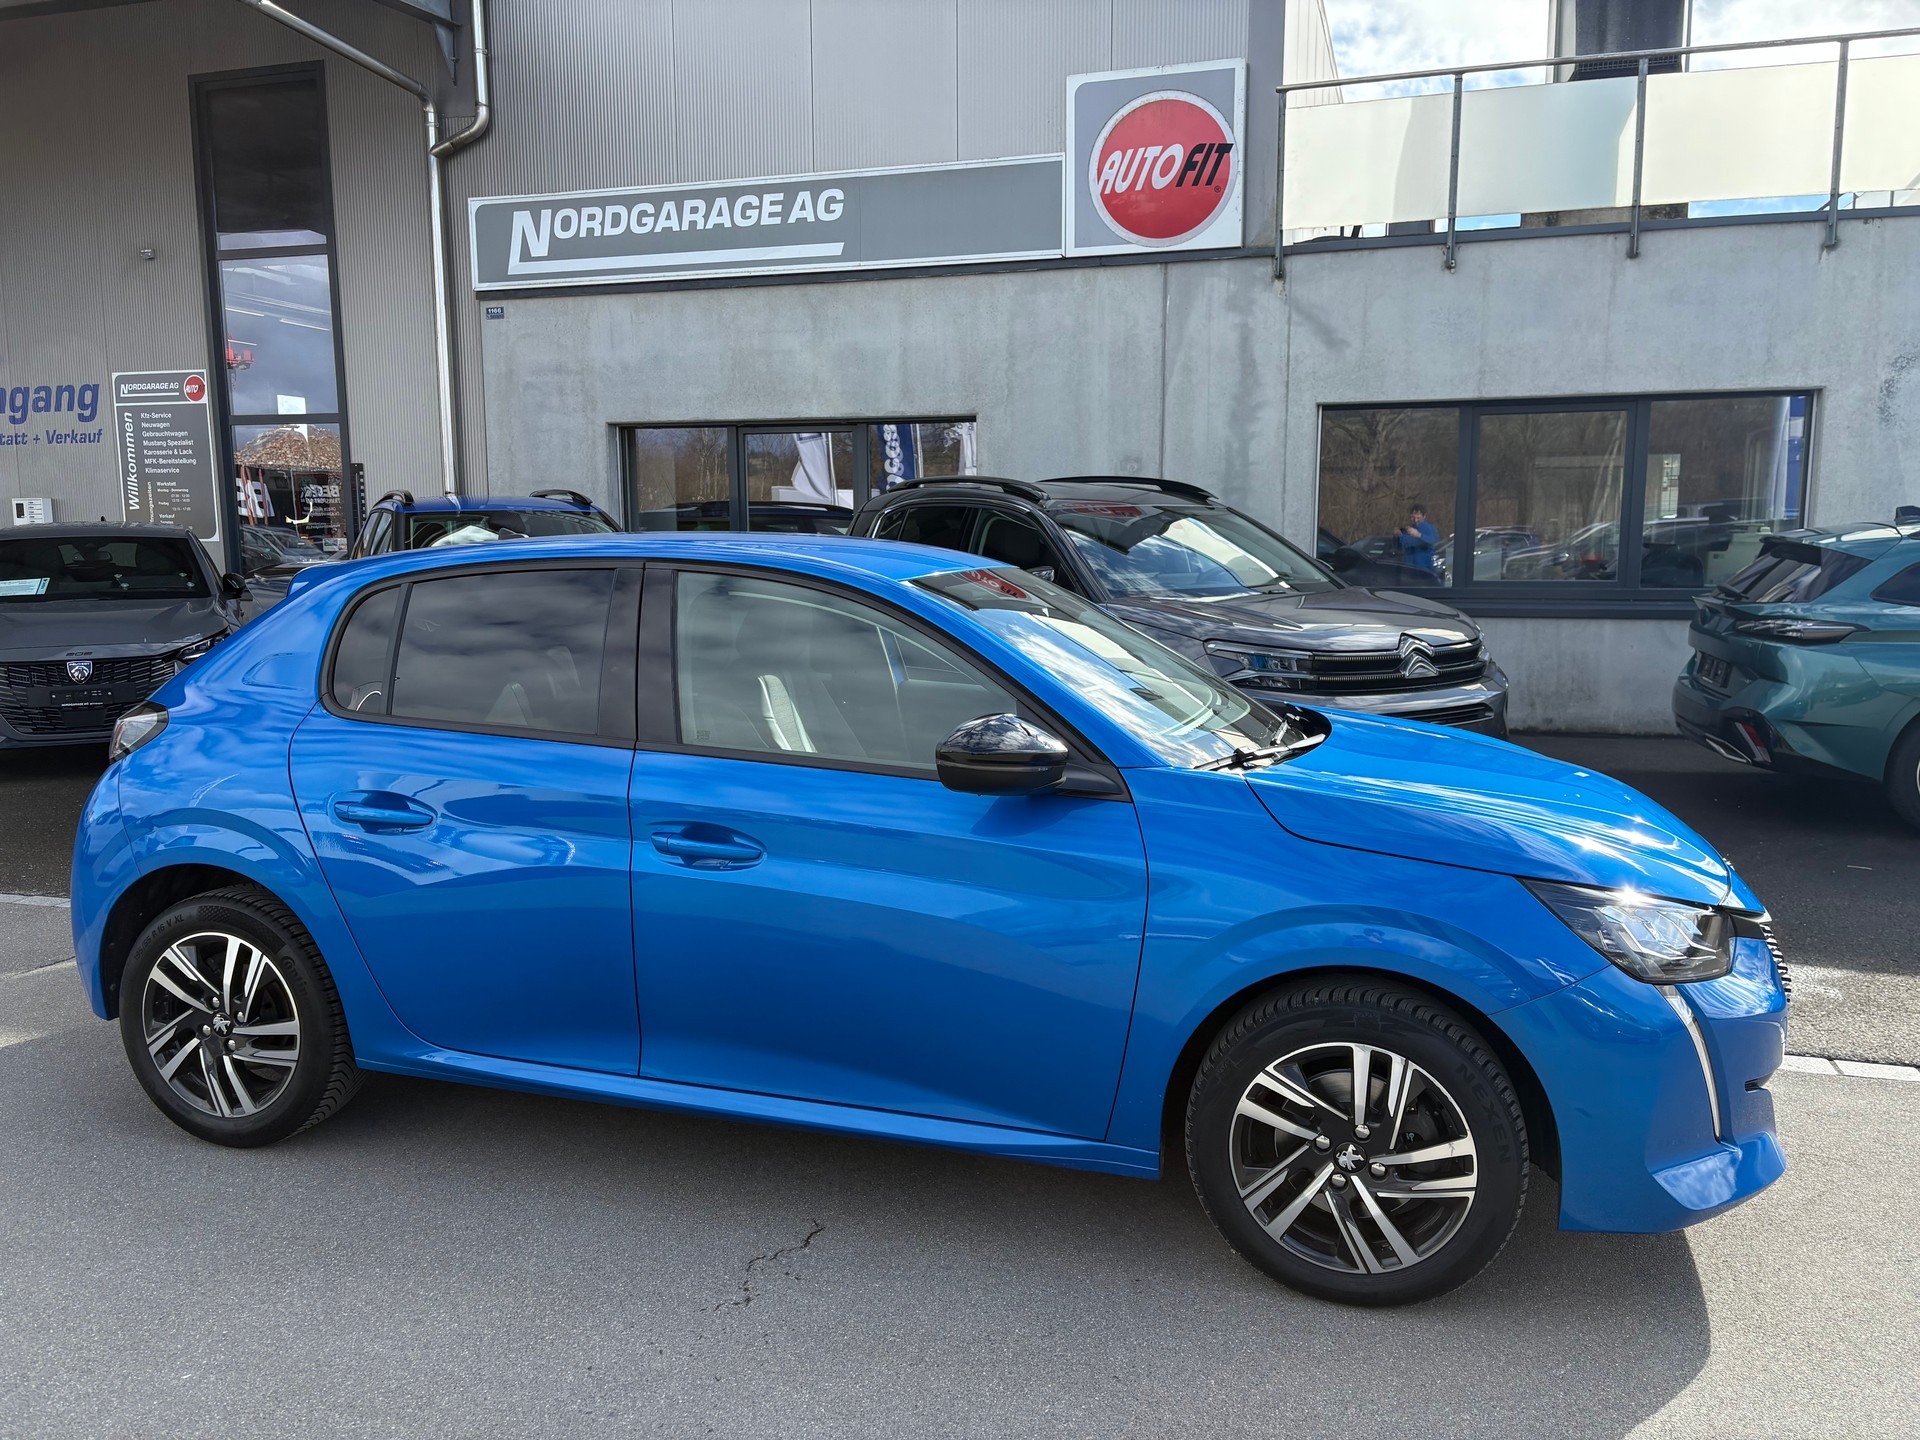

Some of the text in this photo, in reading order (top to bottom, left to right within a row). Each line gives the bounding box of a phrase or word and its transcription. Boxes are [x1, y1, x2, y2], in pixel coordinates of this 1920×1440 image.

[1098, 143, 1234, 195] AUTOFIT
[508, 187, 845, 272] NORDGARAGE AG
[120, 382, 169, 395] NORDGARAGE
[141, 421, 171, 429] Neuwagen
[33, 434, 41, 445] +
[46, 429, 103, 445] Verkauf
[167, 439, 194, 447] Spezialist
[124, 412, 140, 511] Willkommen
[174, 914, 184, 924] XL
[1456, 1062, 1512, 1164] NEXEN
